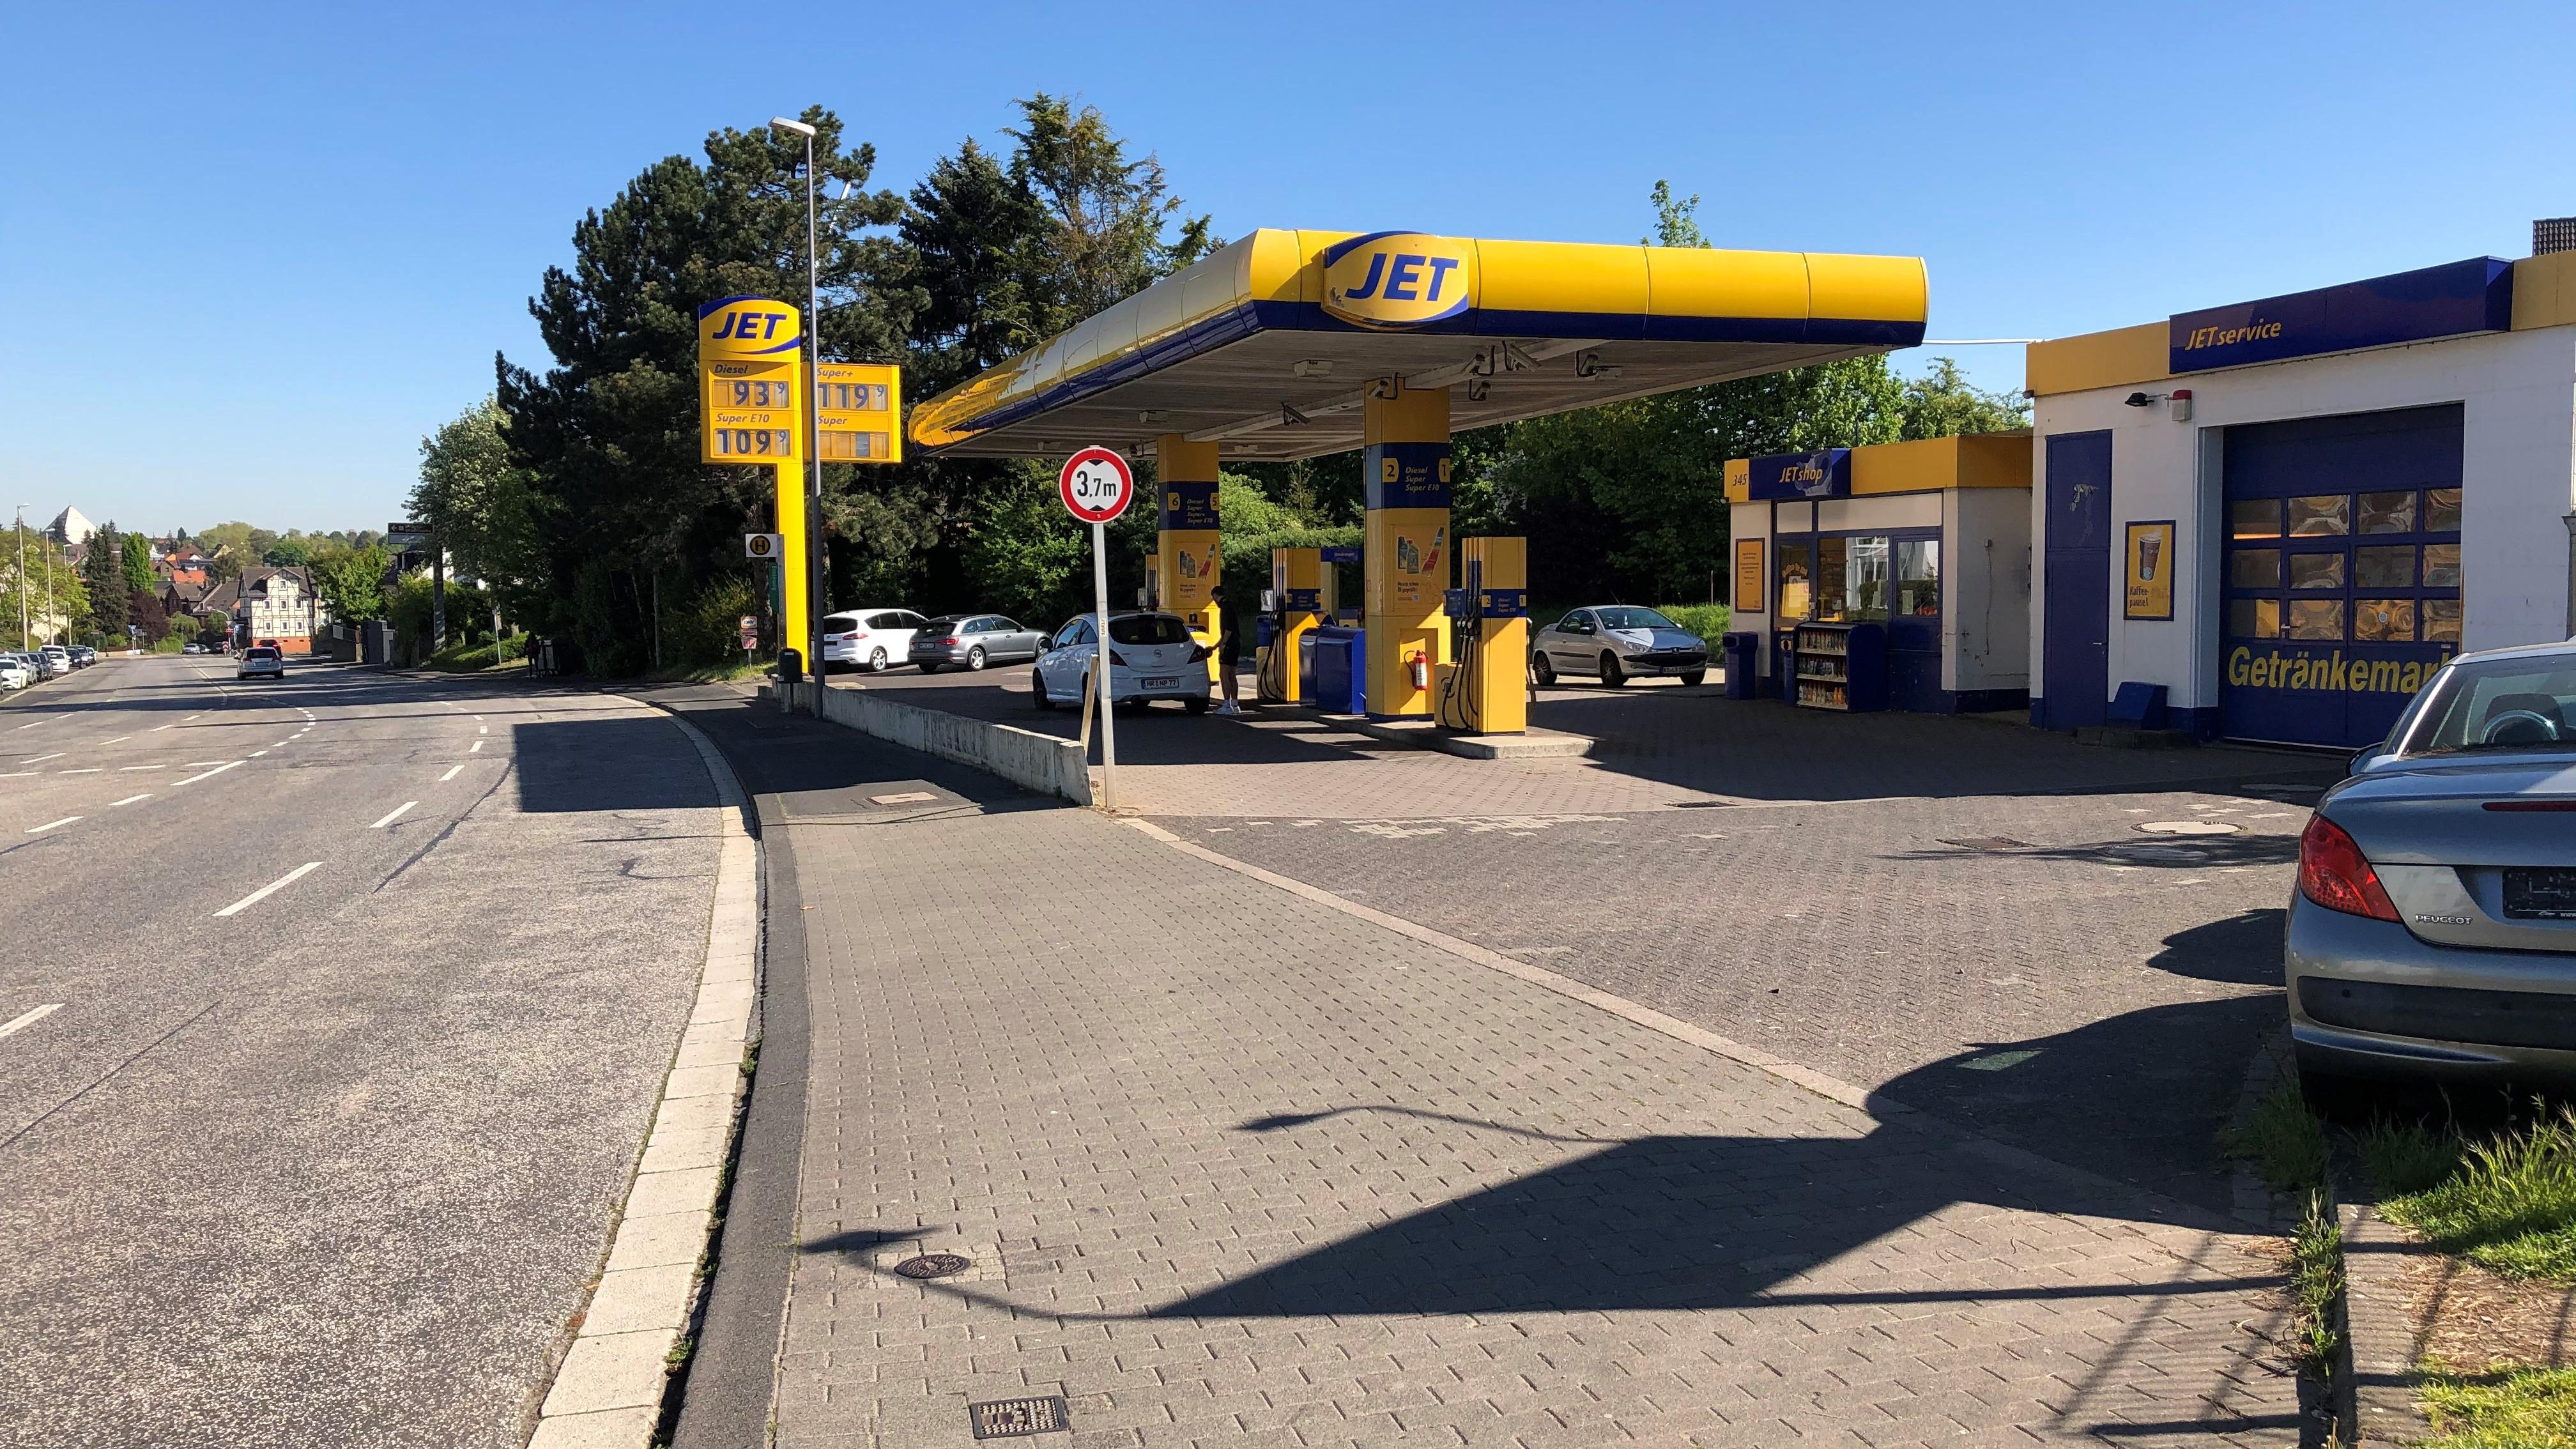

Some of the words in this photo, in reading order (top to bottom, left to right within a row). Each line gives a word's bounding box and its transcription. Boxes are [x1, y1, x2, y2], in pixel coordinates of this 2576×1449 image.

[1344, 253, 1459, 302] JET
[712, 312, 787, 340] JET
[714, 364, 749, 374] Diesel
[716, 413, 747, 425] Super
[750, 414, 770, 423] E10
[818, 416, 848, 427] Super
[1386, 464, 1395, 477] 2
[1441, 464, 1446, 477] 1
[1405, 475, 1426, 484] Super
[1732, 473, 1747, 486] 345
[1405, 484, 1427, 493] Super
[1172, 496, 1179, 506] 6
[1212, 496, 1217, 506] 5
[755, 540, 765, 552] H
[2414, 914, 2473, 924] PEUGEOT
